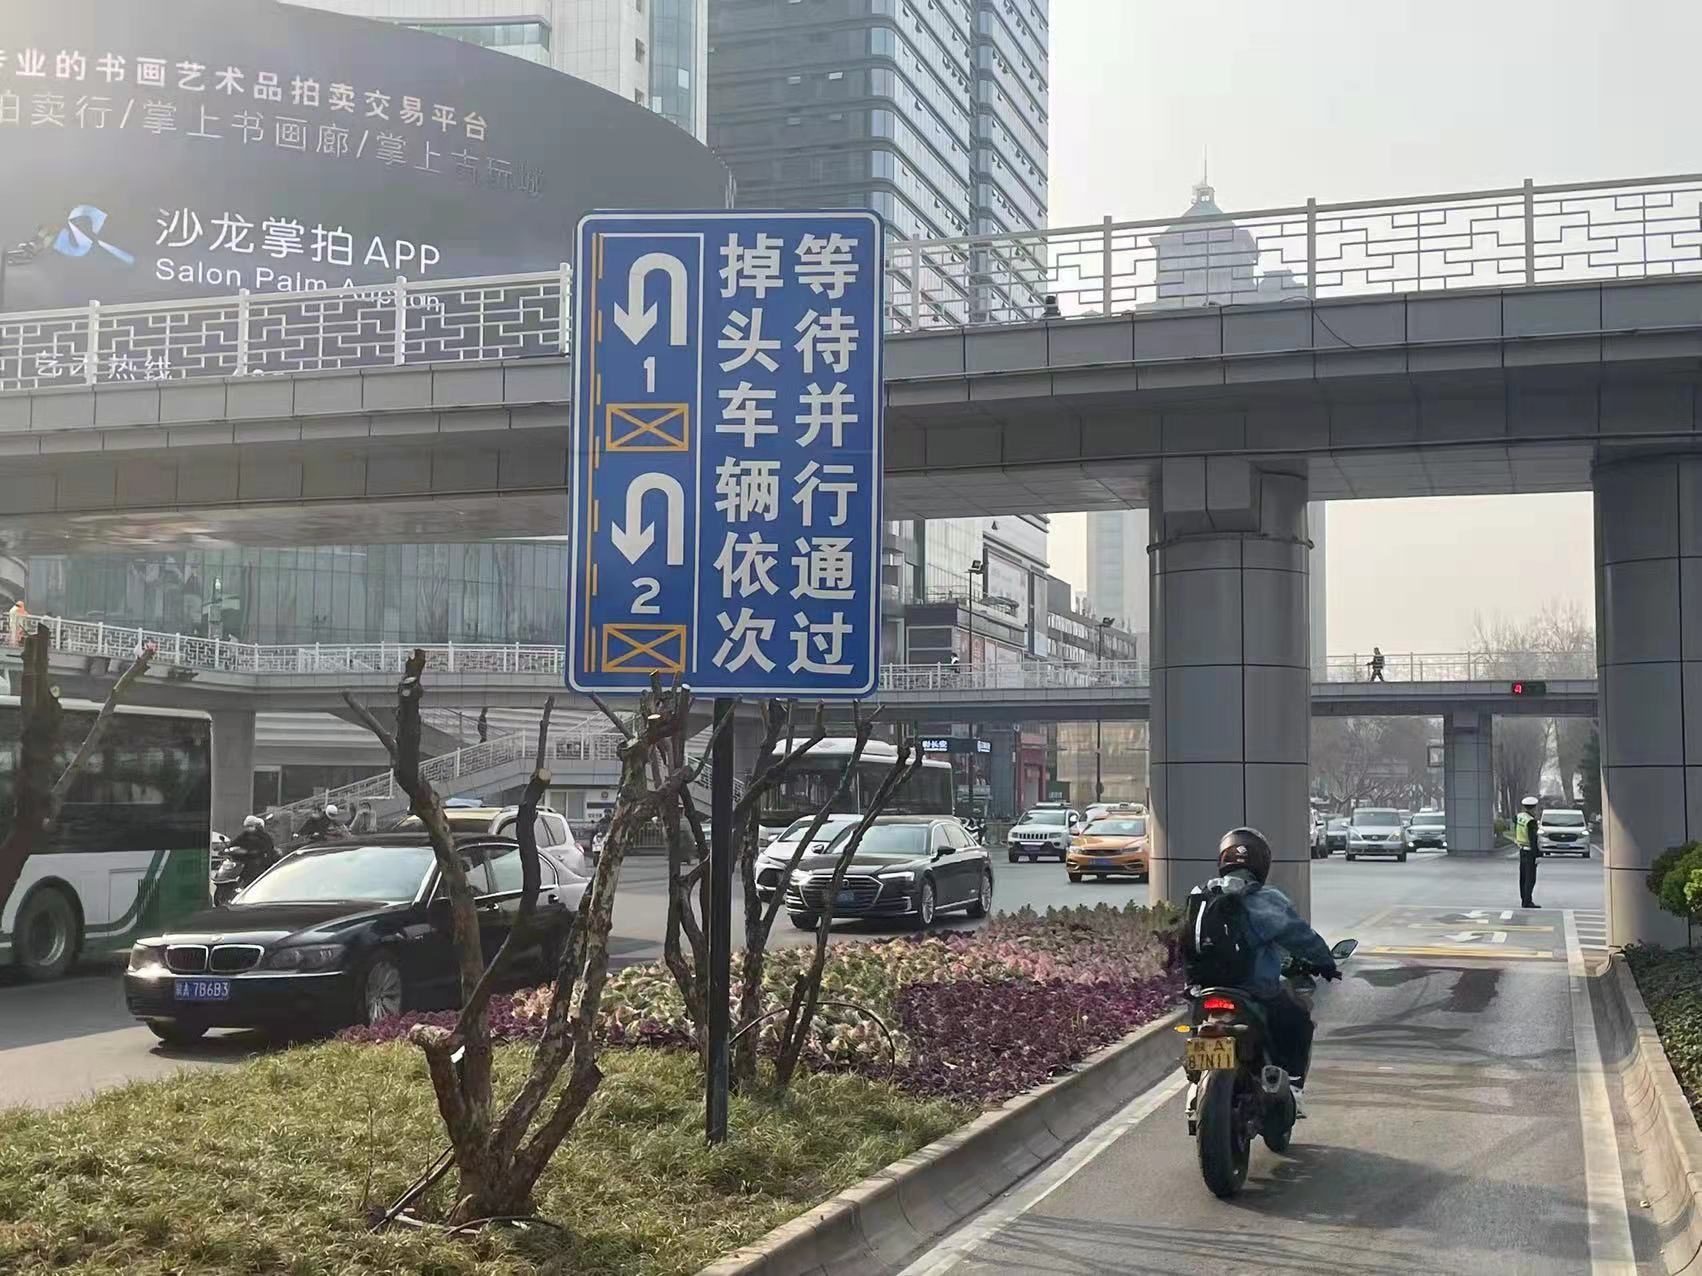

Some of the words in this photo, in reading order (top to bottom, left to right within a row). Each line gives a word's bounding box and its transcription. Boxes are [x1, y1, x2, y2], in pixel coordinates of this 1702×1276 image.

[0, 48, 488, 141] 业的书画艺术品拍卖交易平台
[156, 258, 241, 287] Salon
[256, 267, 327, 292] Palm
[643, 356, 656, 393] 1
[712, 232, 783, 674] 掉头车辆依次
[788, 232, 859, 675] 等待并行通过
[630, 577, 660, 614] 2
